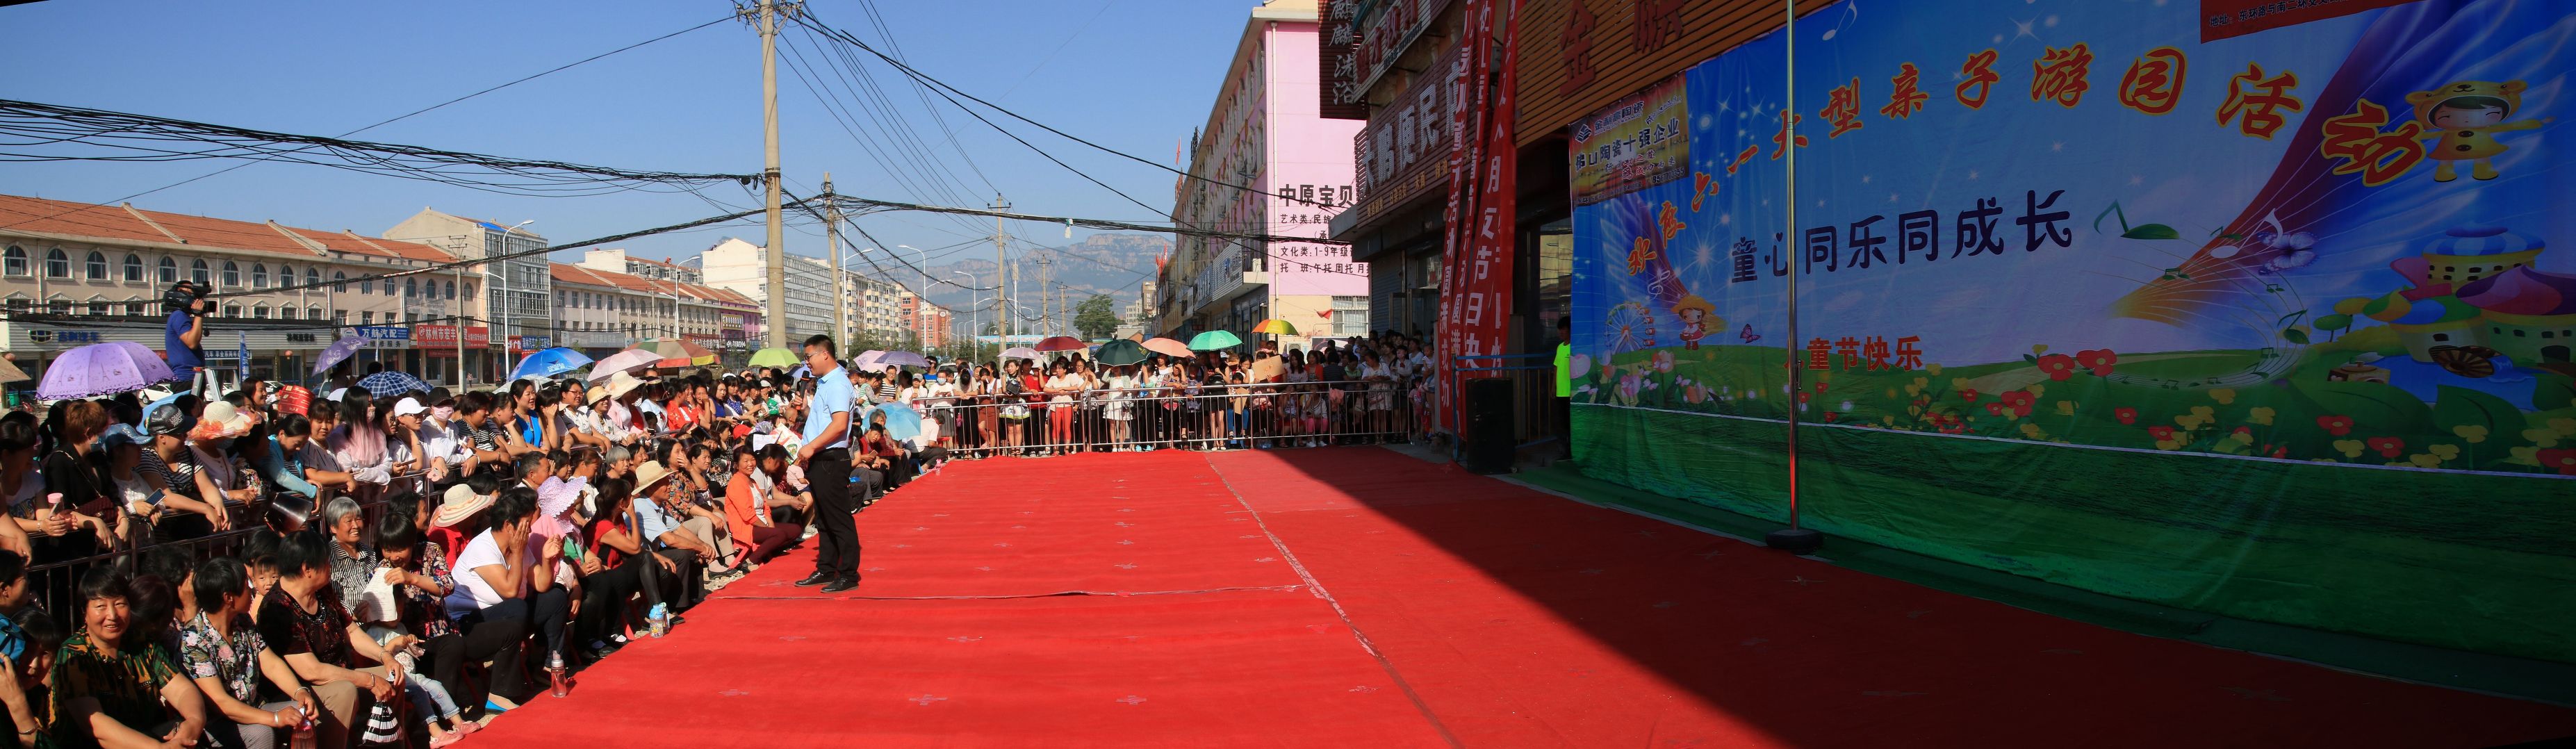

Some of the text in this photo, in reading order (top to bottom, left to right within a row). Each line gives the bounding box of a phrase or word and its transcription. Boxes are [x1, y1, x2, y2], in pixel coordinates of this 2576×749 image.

[1575, 117, 1680, 172] 佛山陶瓷十强企业
[1279, 184, 1354, 207] 中原宝贝
[1731, 189, 2073, 283] 童心同乐同成长
[1280, 246, 1352, 258] 文化类:1-9年级
[362, 329, 397, 338] 万航汽配
[425, 327, 468, 340] 林州市宏丰贸
